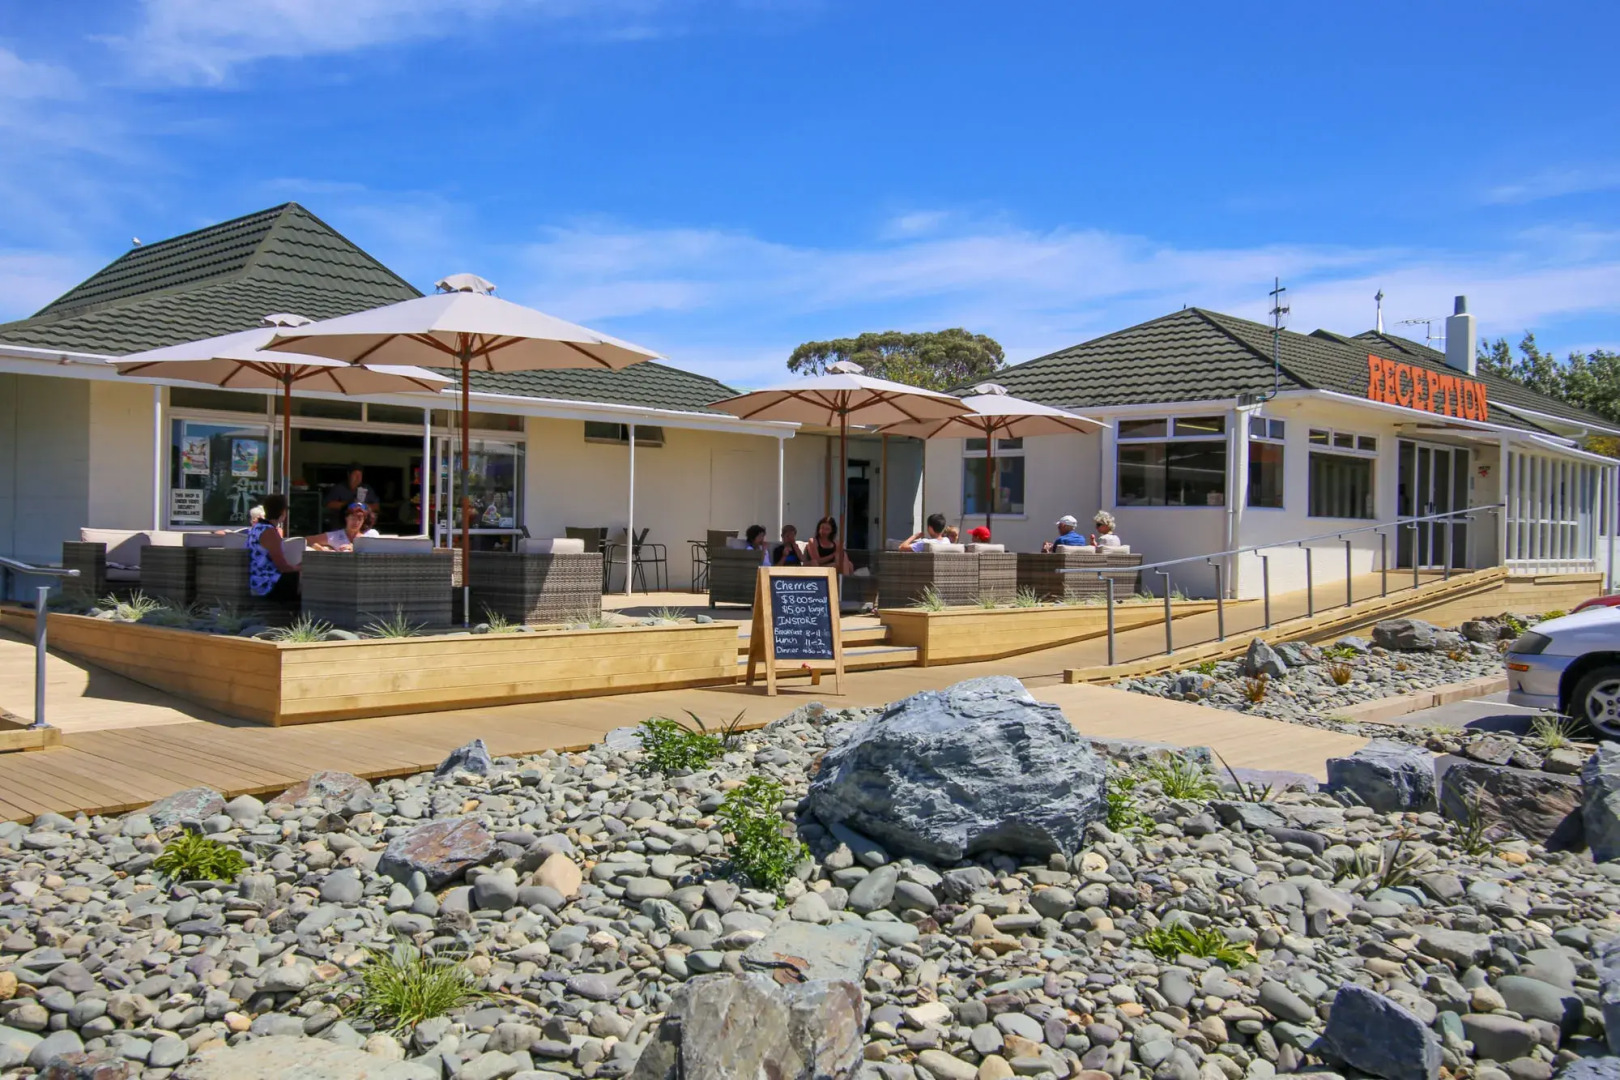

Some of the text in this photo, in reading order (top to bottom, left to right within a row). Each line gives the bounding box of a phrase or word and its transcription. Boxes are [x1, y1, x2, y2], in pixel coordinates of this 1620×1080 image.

[1368, 354, 1488, 421] RECEPTION
[775, 580, 819, 591] Cherries
[775, 635, 798, 644] Lunch
